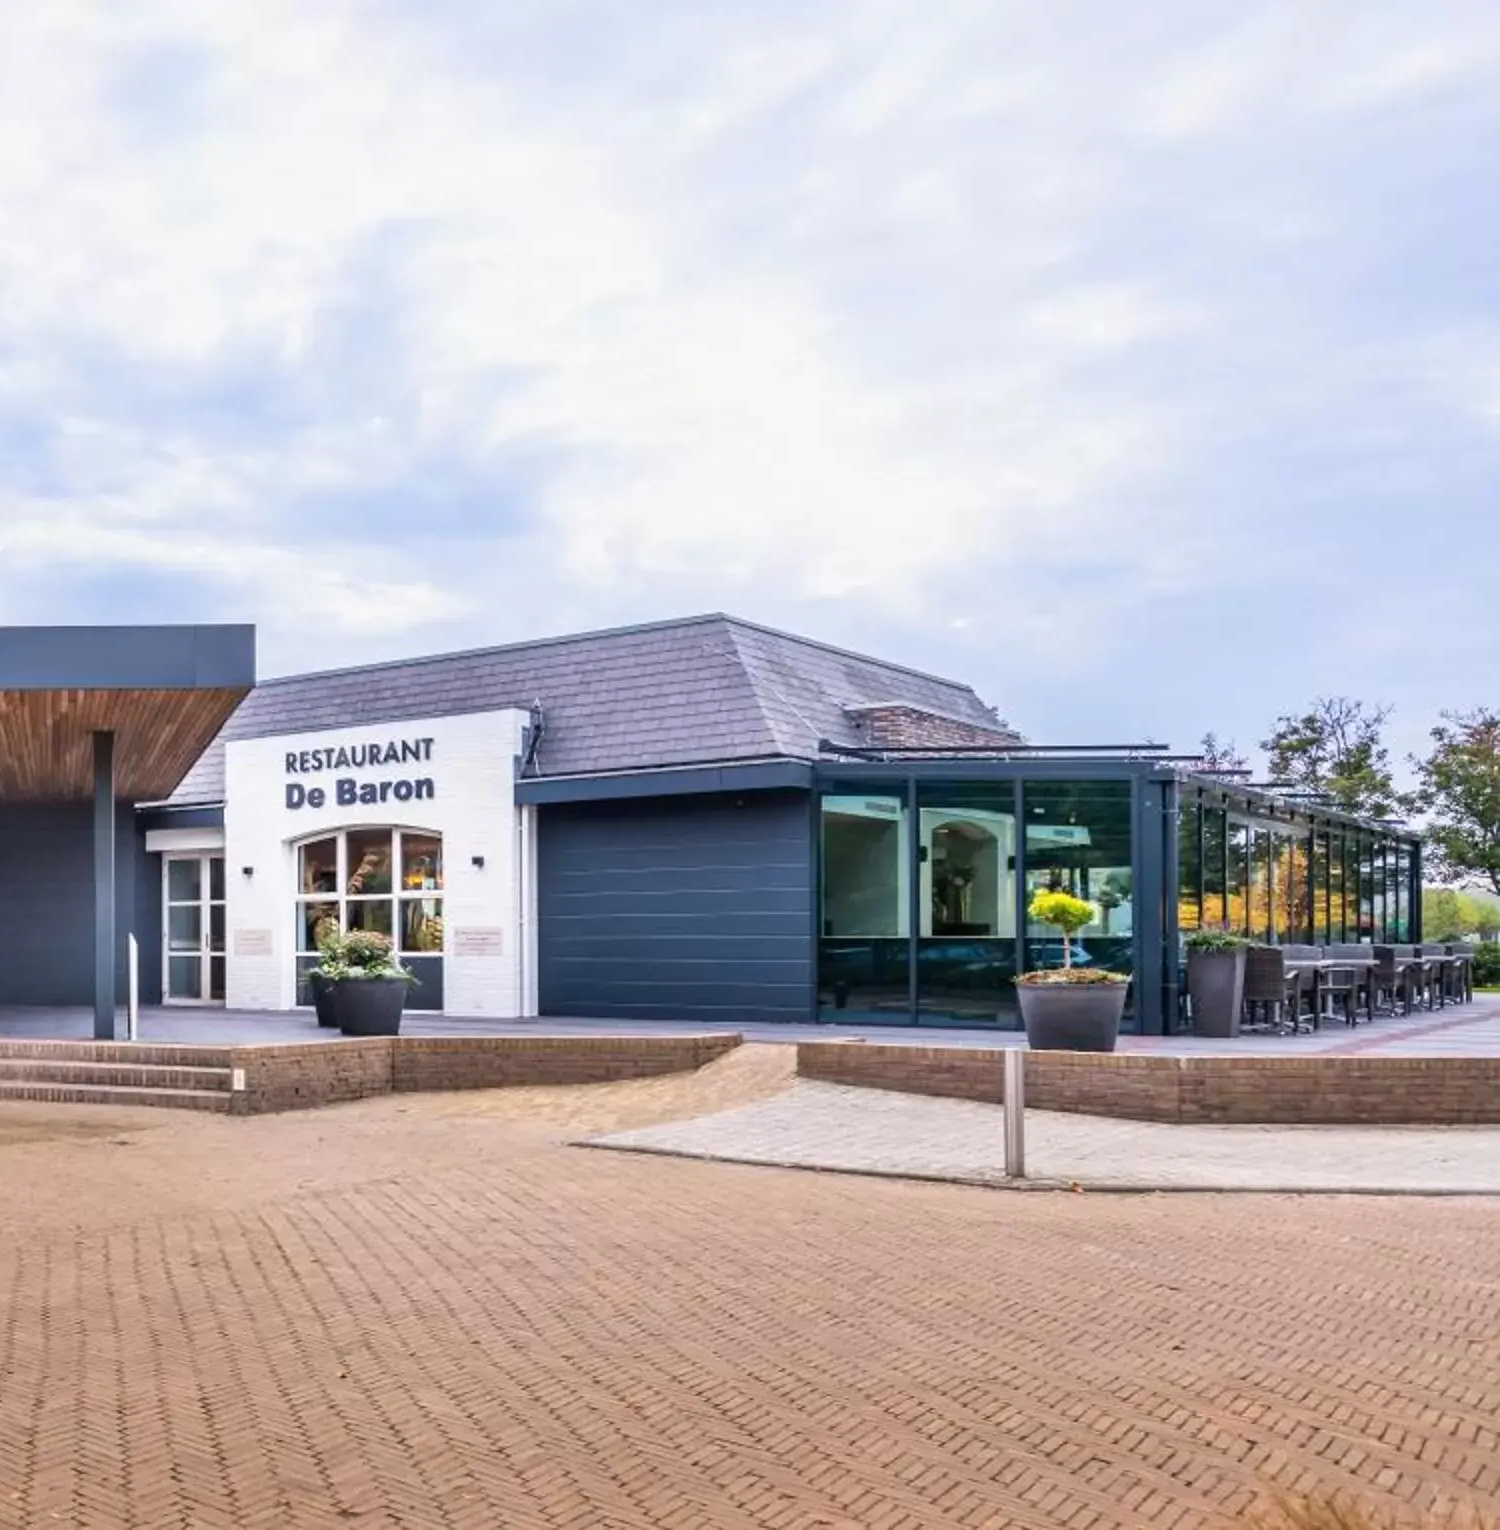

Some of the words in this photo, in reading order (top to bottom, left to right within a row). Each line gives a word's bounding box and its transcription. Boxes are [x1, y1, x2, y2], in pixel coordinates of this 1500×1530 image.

[285, 738, 434, 774] RESTAURANT
[285, 783, 325, 810] De
[336, 776, 435, 806] Baron
